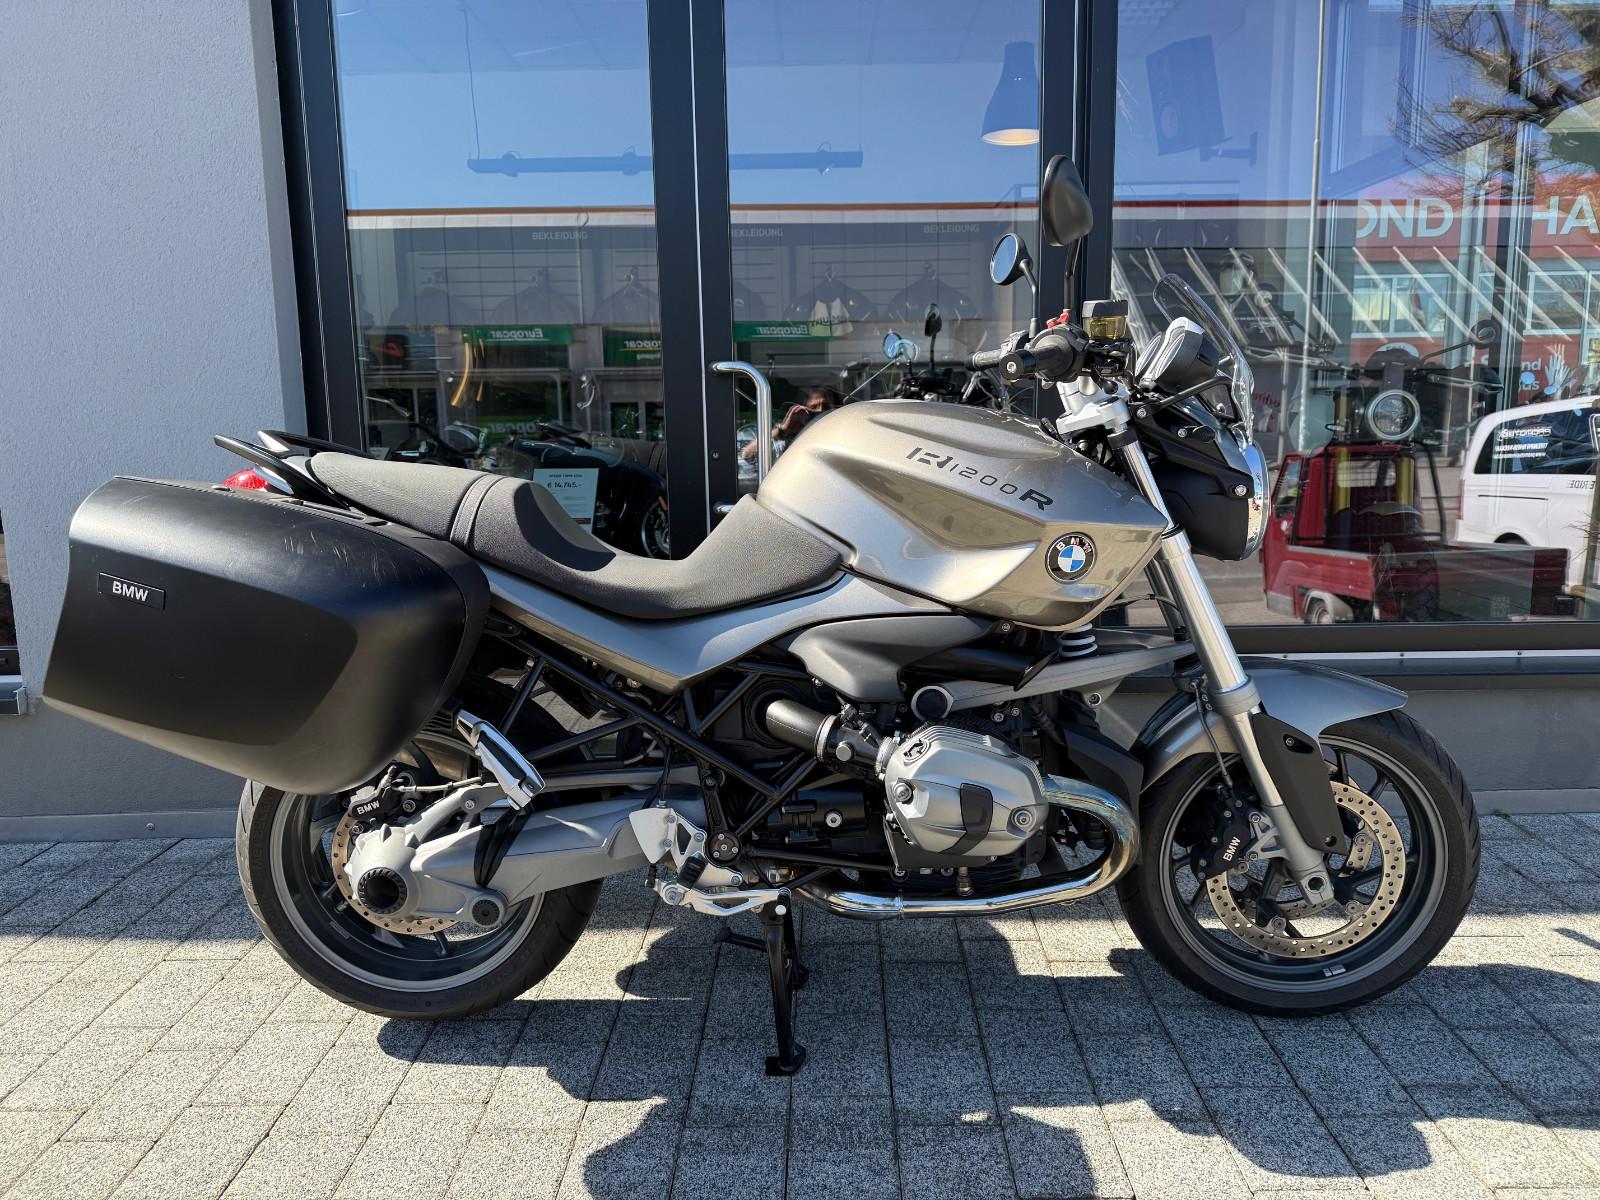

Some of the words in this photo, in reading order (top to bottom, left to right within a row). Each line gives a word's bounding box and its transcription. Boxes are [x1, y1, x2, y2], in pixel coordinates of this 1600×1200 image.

[532, 231, 588, 240] BEKLEIDUNG
[923, 224, 980, 234] BEKLEIDUNG
[1056, 537, 1092, 554] BMW
[112, 581, 149, 602] BMW
[357, 800, 380, 815] BMW
[1223, 836, 1241, 861] BMW
